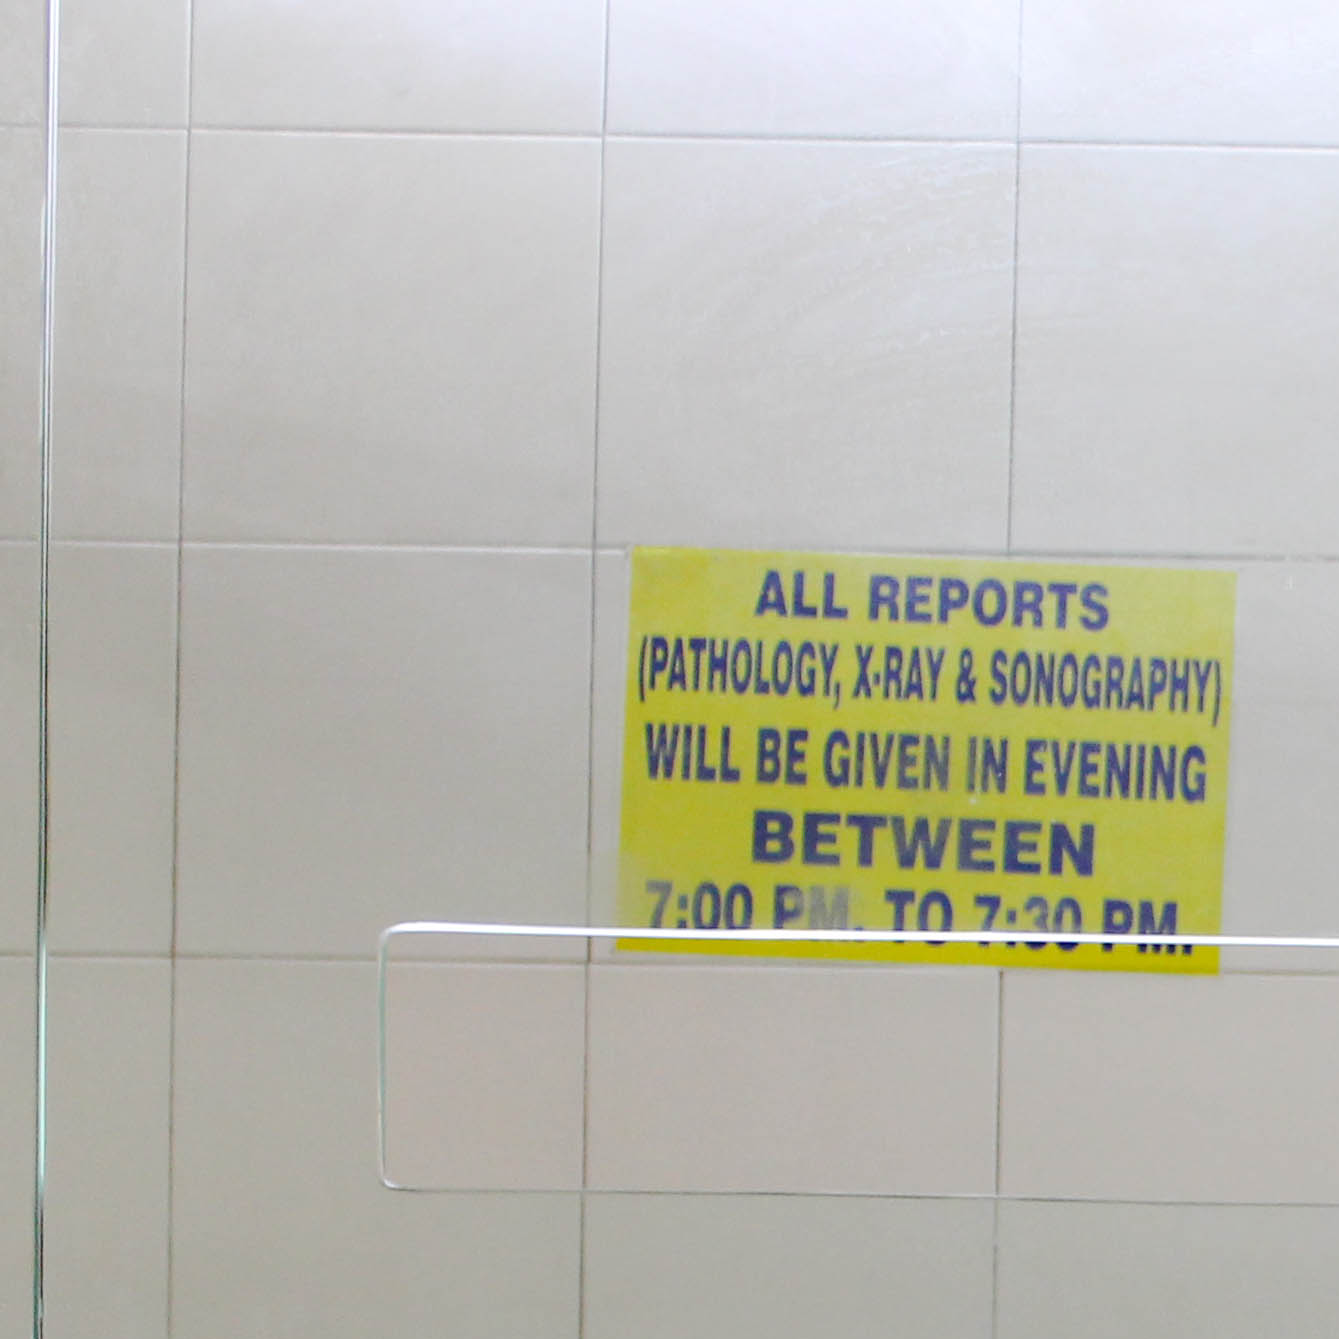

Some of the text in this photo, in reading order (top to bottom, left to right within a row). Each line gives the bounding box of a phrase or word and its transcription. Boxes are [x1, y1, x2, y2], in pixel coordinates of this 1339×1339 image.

[755, 570, 1111, 632] ALL REPORTS
[639, 636, 1223, 727] (PATHOLOGY, X-RAY & SONOGRAPHY)
[645, 723, 1207, 804] WILL BE GIVEN IN EVENING
[752, 810, 1096, 877] BETWEEN
[884, 890, 953, 947] TO
[974, 895, 1083, 952] 7:30
